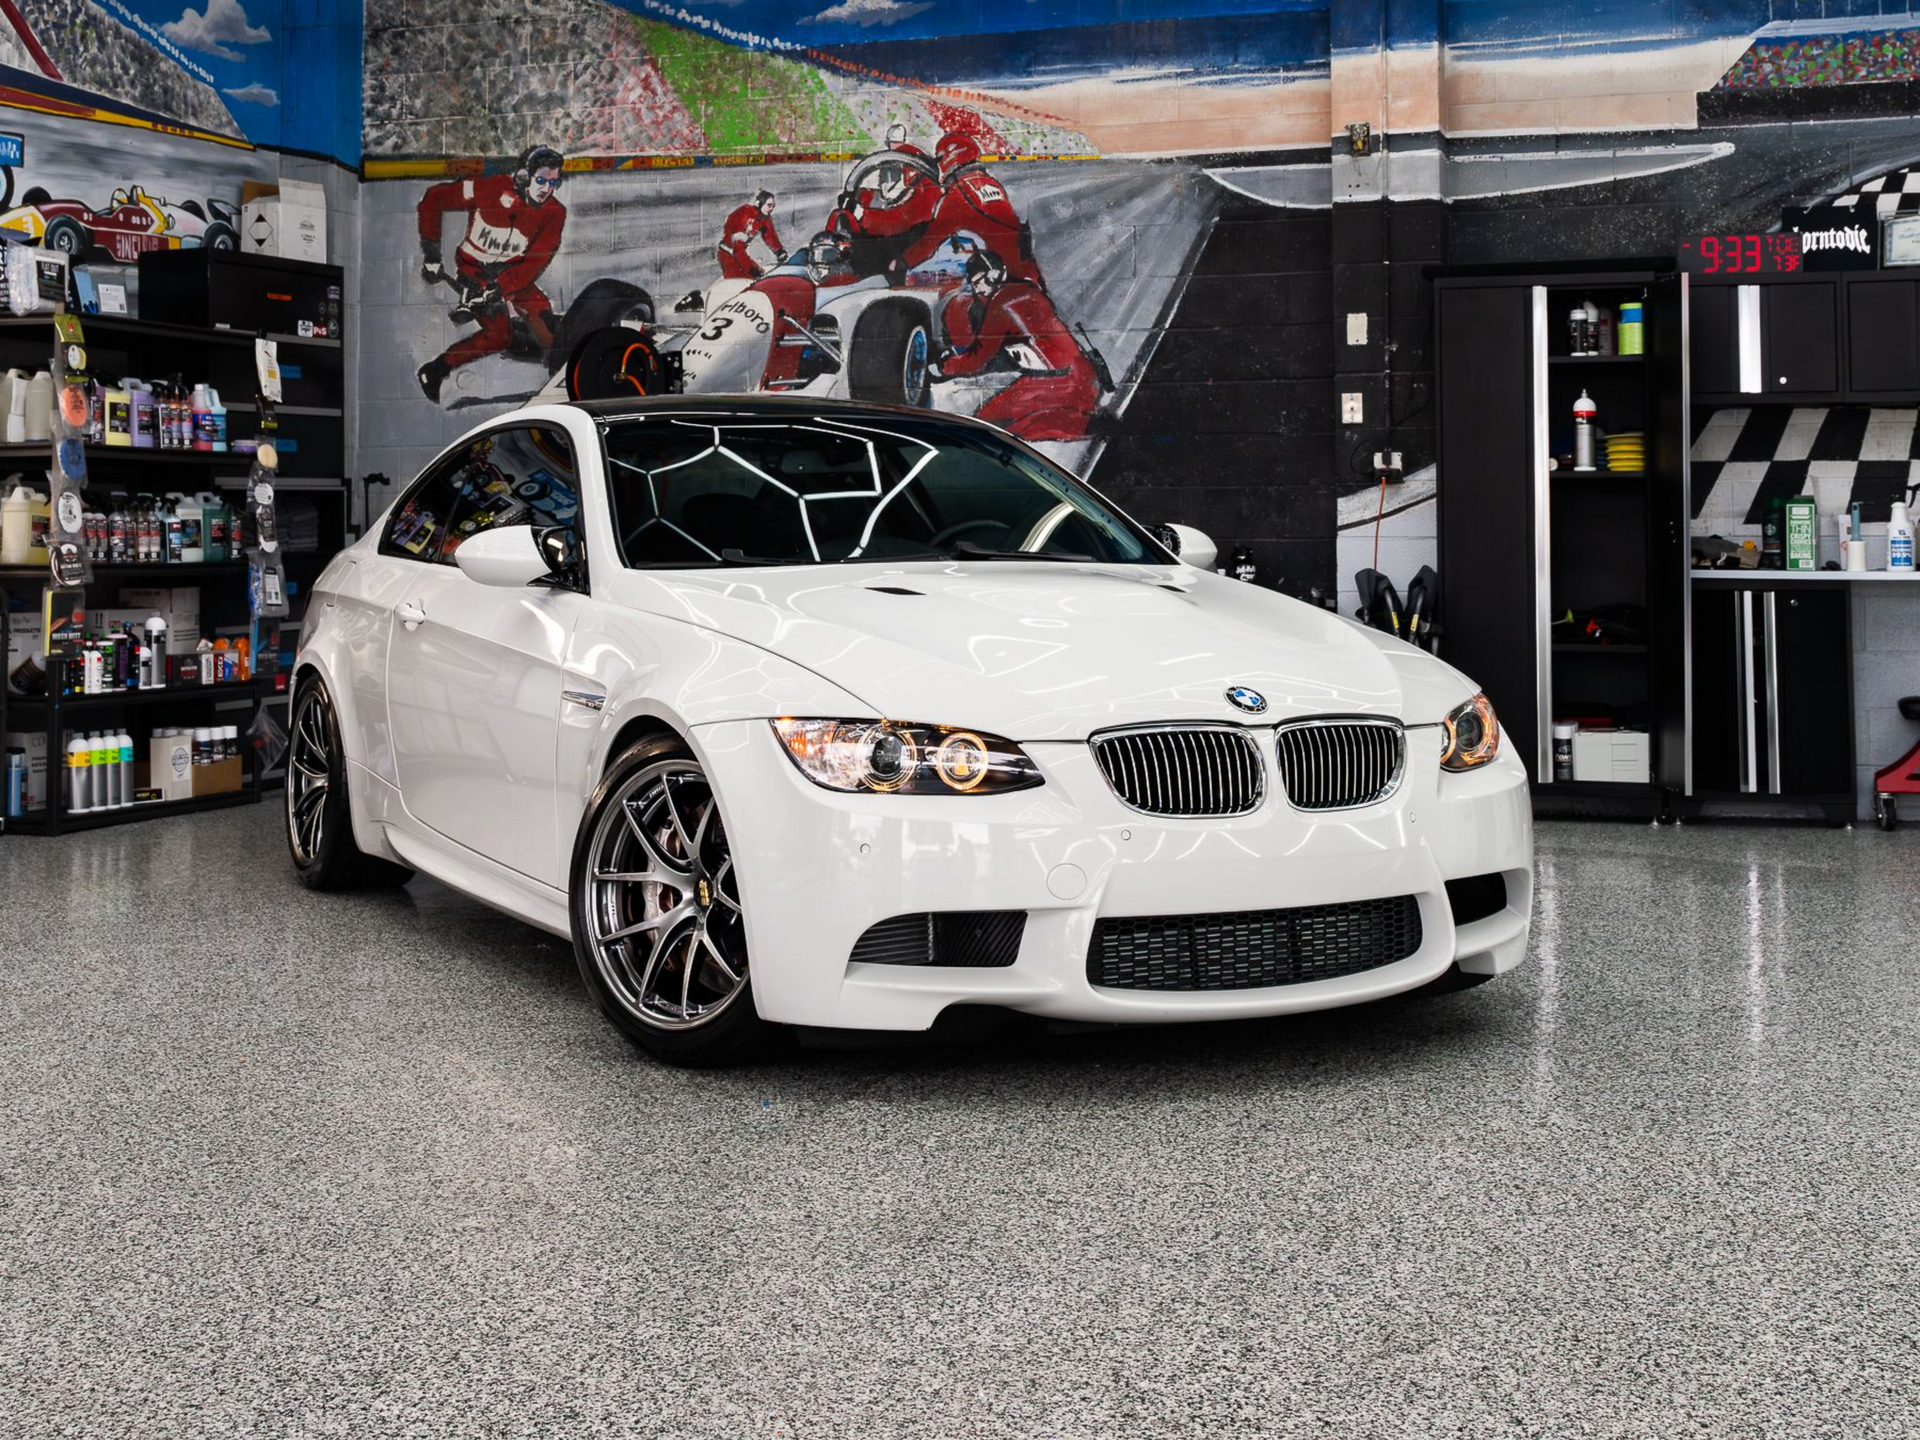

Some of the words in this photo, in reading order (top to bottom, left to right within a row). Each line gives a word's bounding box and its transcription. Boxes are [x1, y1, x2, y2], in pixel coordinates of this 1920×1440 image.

[1700, 235, 1761, 273] 9:33
[700, 317, 733, 341] 3
[1790, 524, 1811, 534] THIN
